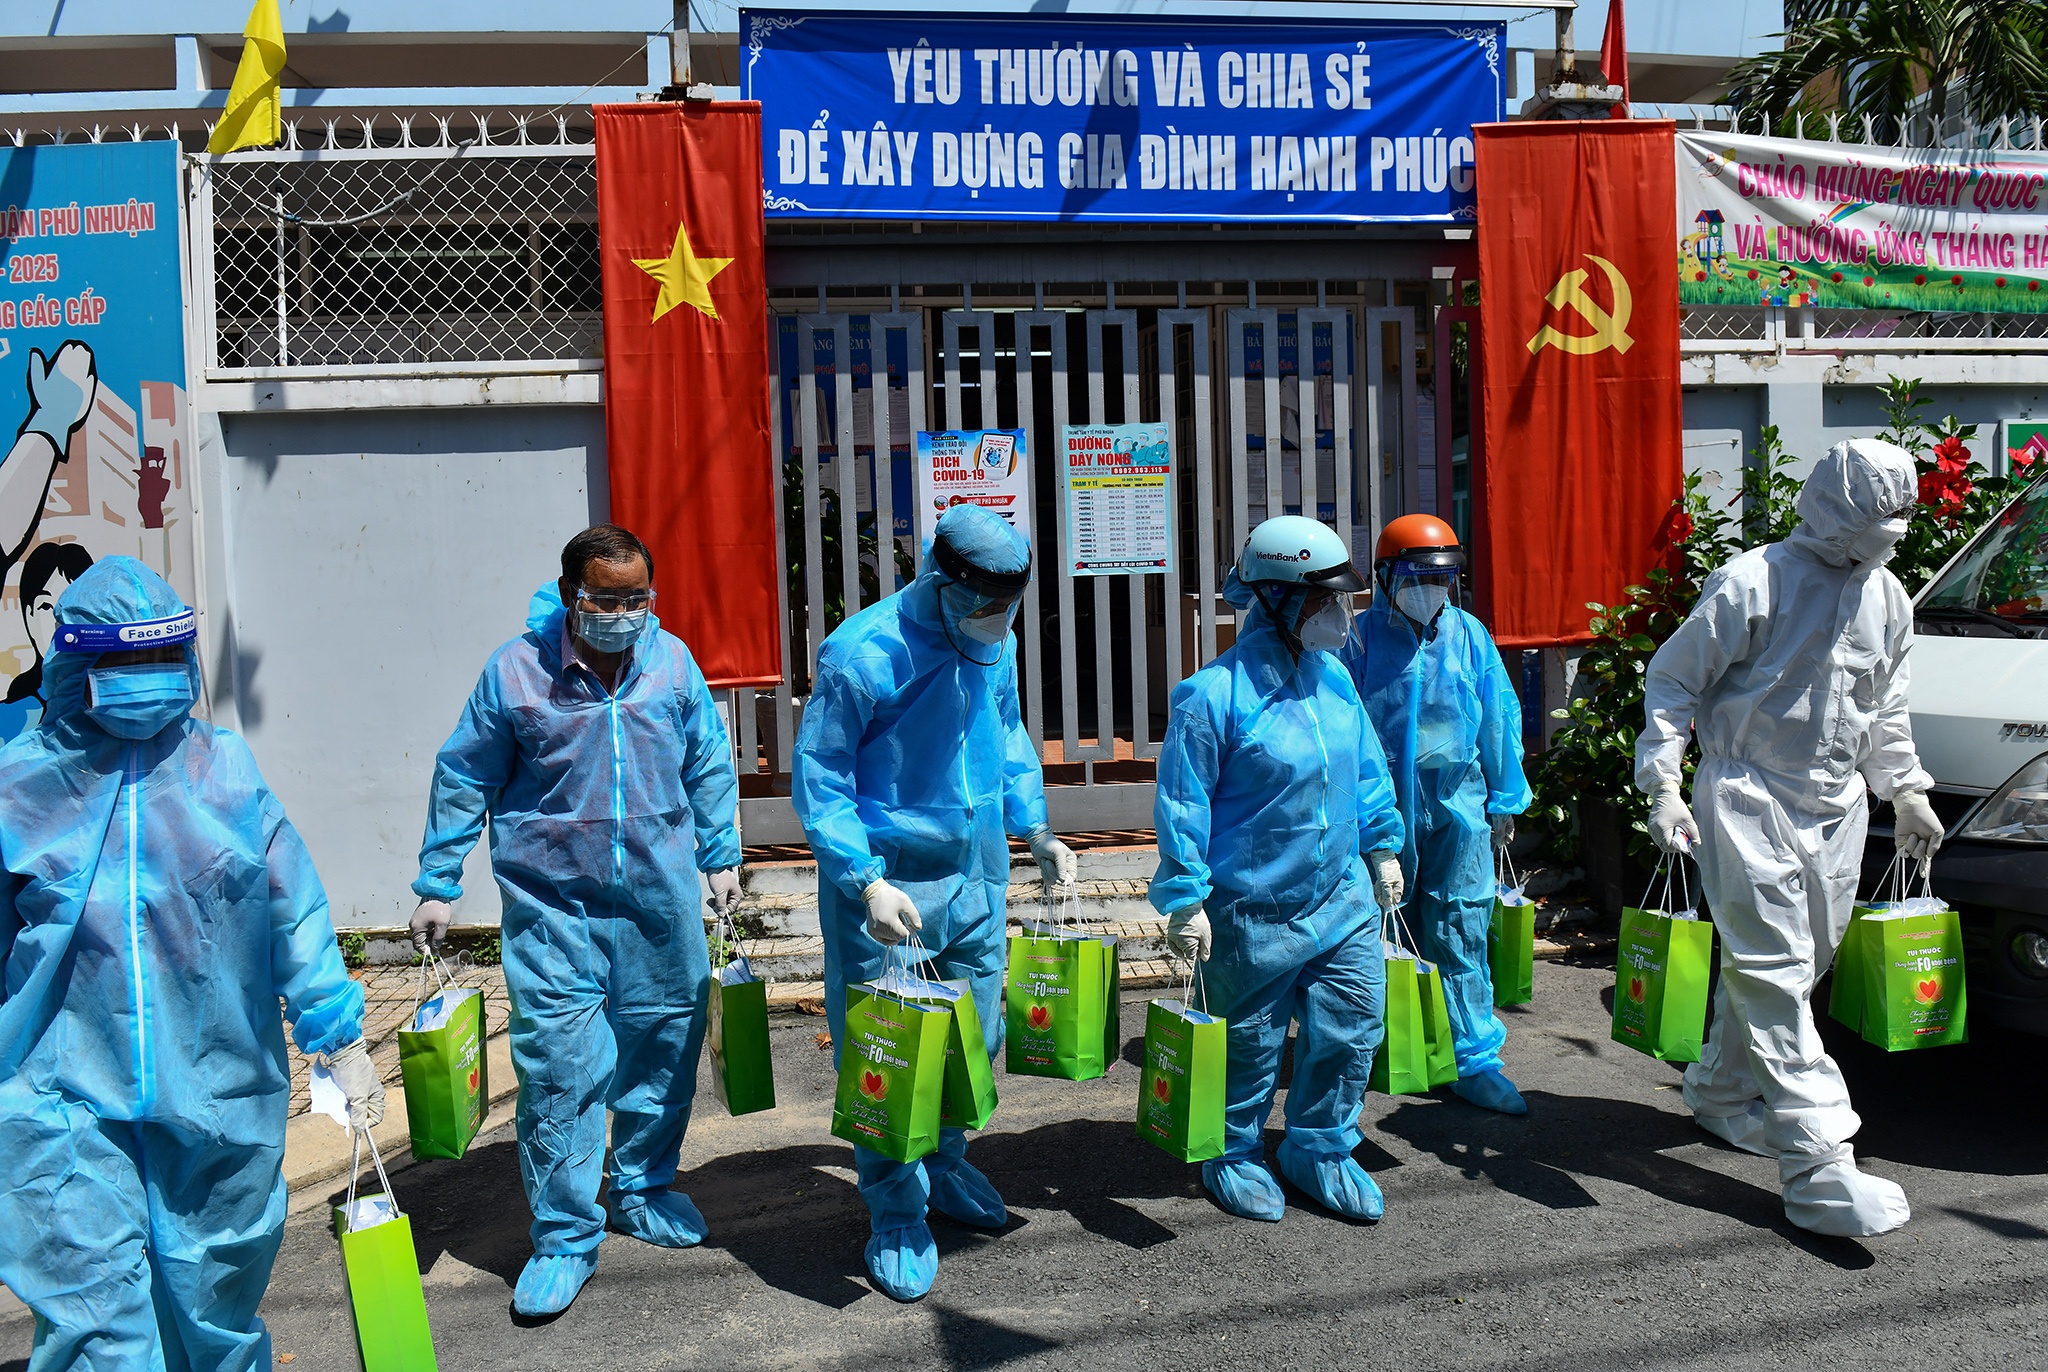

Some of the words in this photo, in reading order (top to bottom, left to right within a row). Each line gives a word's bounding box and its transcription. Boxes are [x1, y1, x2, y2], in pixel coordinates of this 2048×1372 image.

[887, 38, 961, 105] YÊU
[974, 40, 1138, 107] THƯƠNG
[1151, 42, 1201, 108] VÀ
[1217, 51, 1313, 110] CHIA
[1325, 41, 1372, 110] SẺ
[778, 109, 829, 185] ĐỂ
[841, 120, 919, 186] XÂY
[932, 124, 1044, 198] DỰNG
[1058, 132, 1128, 190] GIA
[1139, 125, 1237, 191] ĐÌNH
[1250, 135, 1357, 202] HẠNH
[1370, 128, 1475, 193] PHÚC
[1738, 153, 1806, 201] CHÀO
[1815, 157, 1893, 204] MỪNG
[39, 201, 80, 237] PHÚ
[85, 197, 155, 238] NHUẬN
[1734, 215, 1769, 261] VÀ
[1776, 213, 1868, 265] HƯỞNG
[1873, 221, 1927, 267] ỨNG
[1931, 223, 2015, 269] THÁNG
[9, 253, 59, 284] 2025
[20, 293, 62, 329] CÁC
[65, 287, 106, 326] CẤP
[1068, 435, 1112, 450] ĐƯỜNG
[932, 456, 960, 470] DỊCH
[1069, 452, 1094, 466] DÂY
[1097, 451, 1131, 466] NÓNG
[933, 468, 985, 482] COVID-19
[1255, 551, 1299, 563] VietinBank
[128, 628, 161, 639] Face
[165, 619, 194, 635] Shield
[133, 640, 164, 648] Protective
